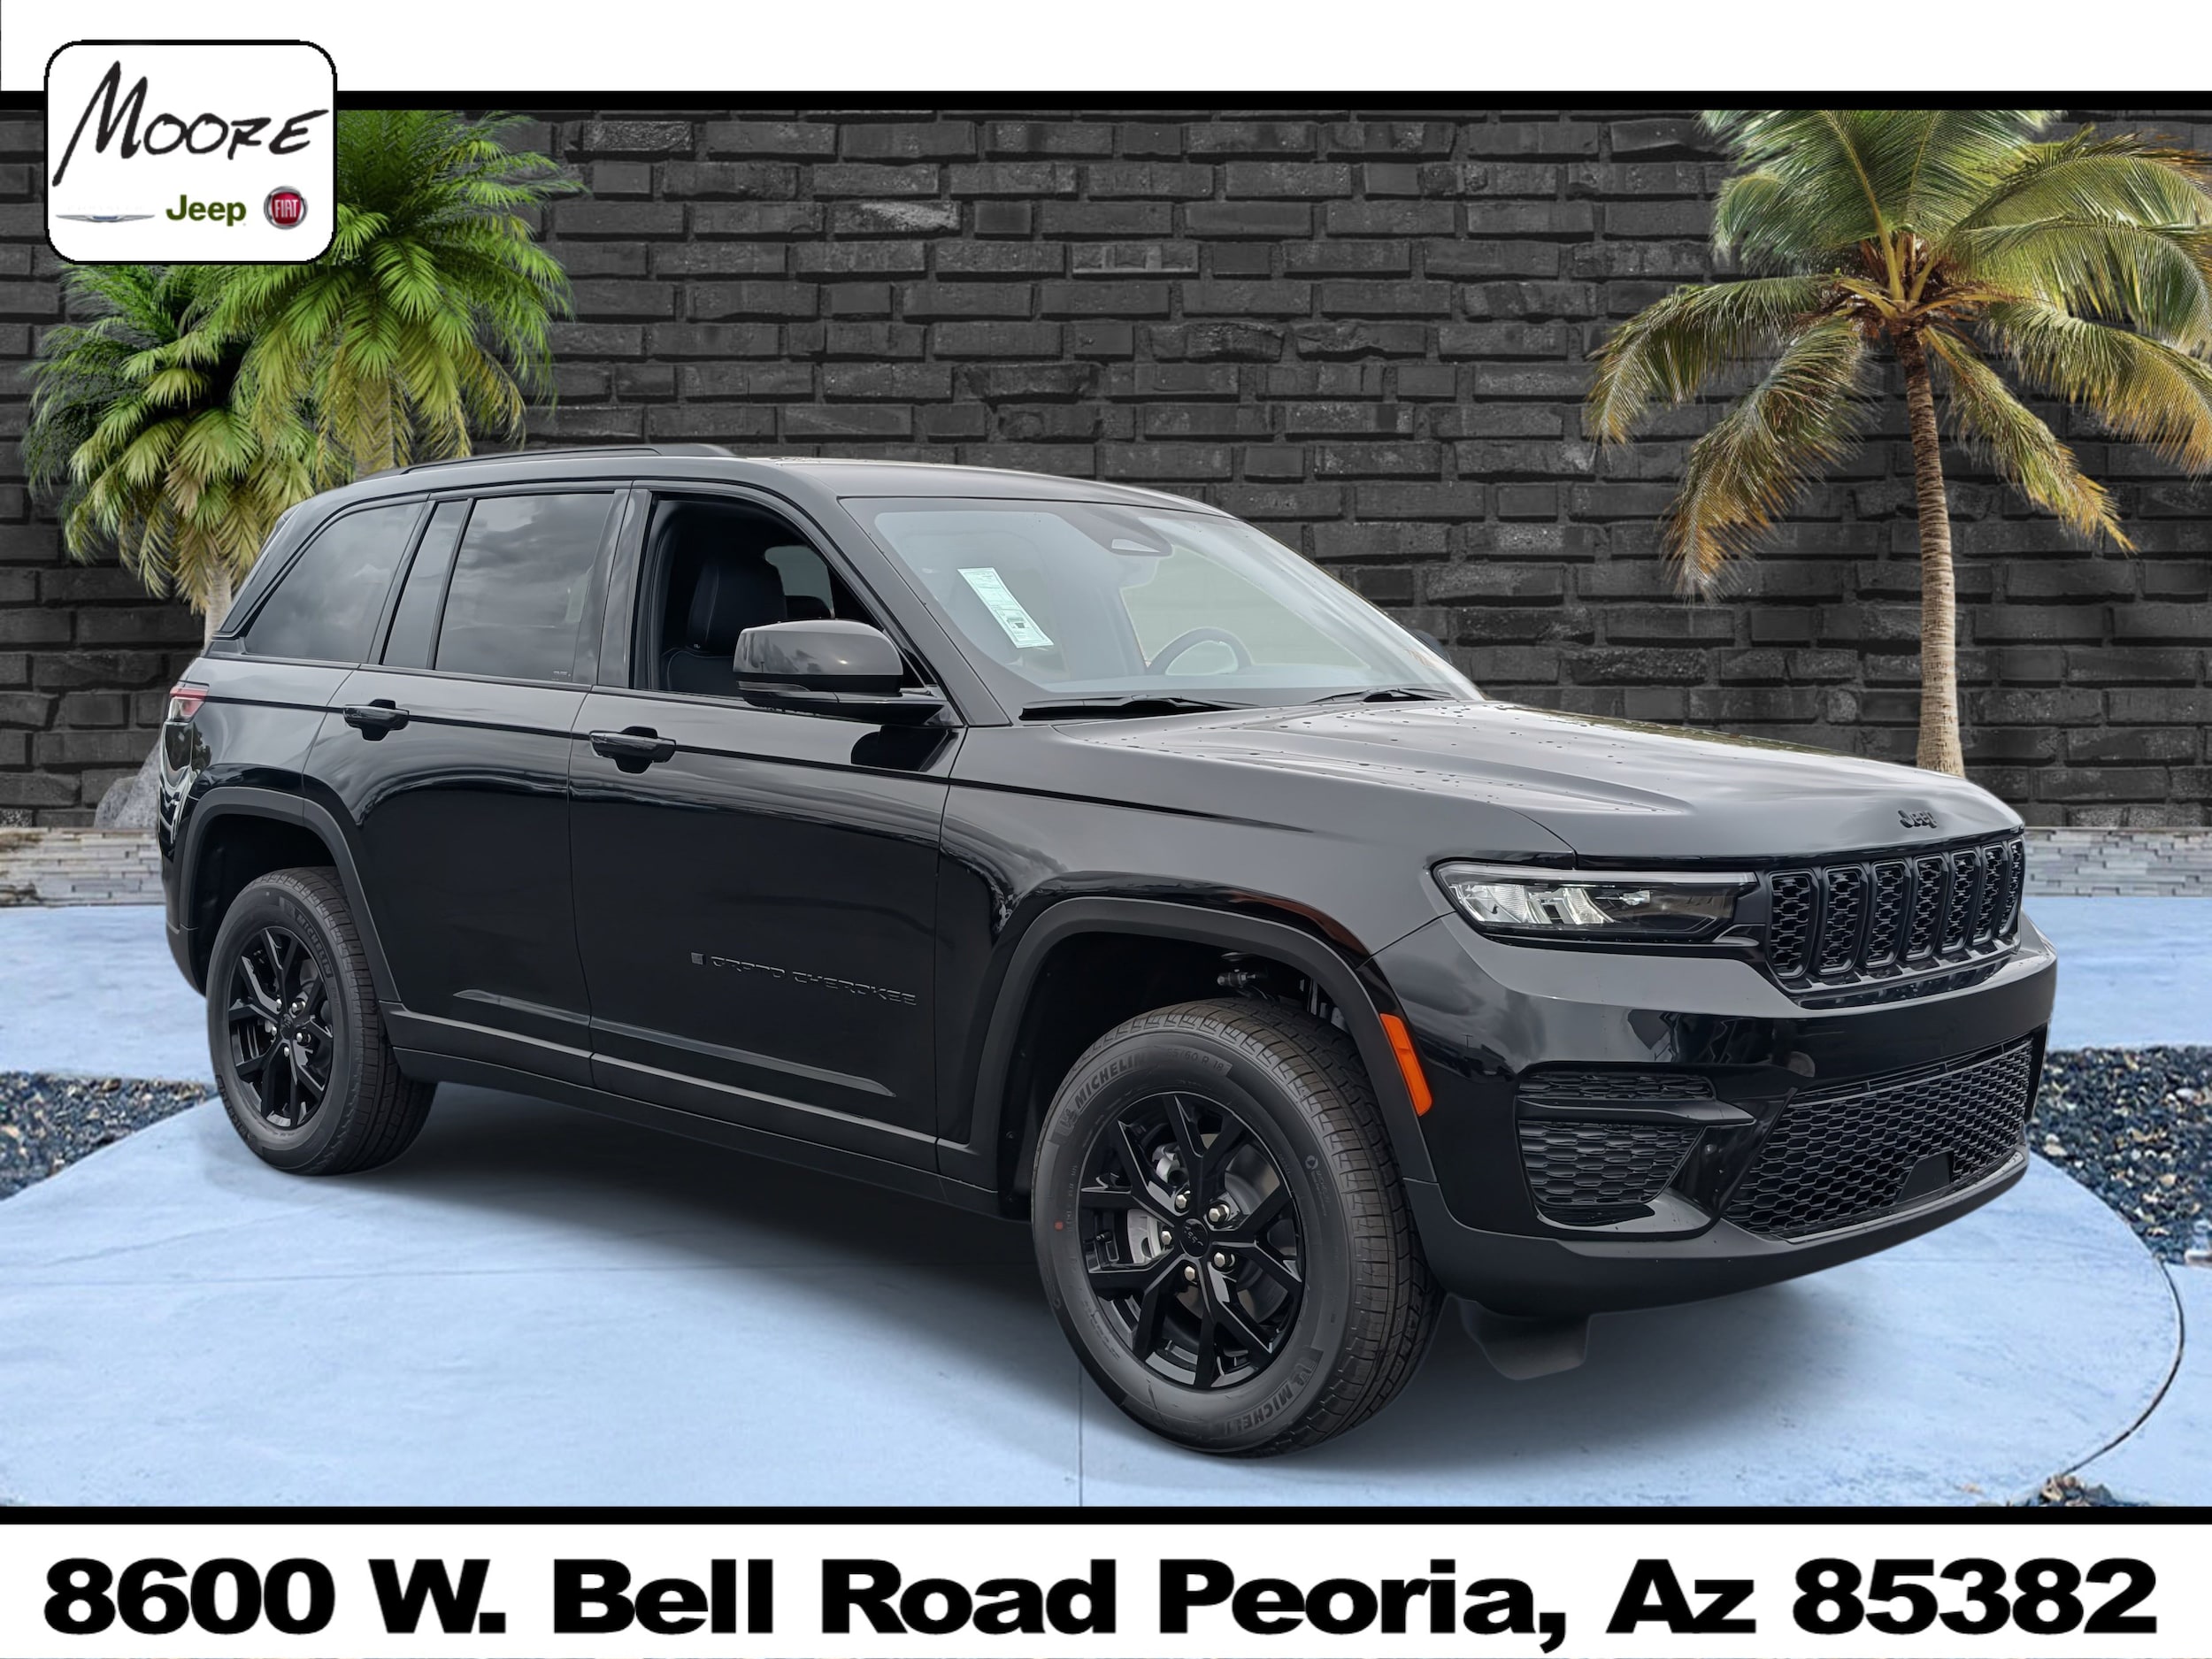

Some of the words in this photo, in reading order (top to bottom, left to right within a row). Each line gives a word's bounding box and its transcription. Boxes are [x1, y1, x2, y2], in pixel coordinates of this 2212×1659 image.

[1898, 810, 1937, 828] Jeep
[793, 972, 917, 1006] CHEROKEE
[1073, 1051, 1148, 1110] MICHELIN
[1219, 1383, 1294, 1437] MICHELI
